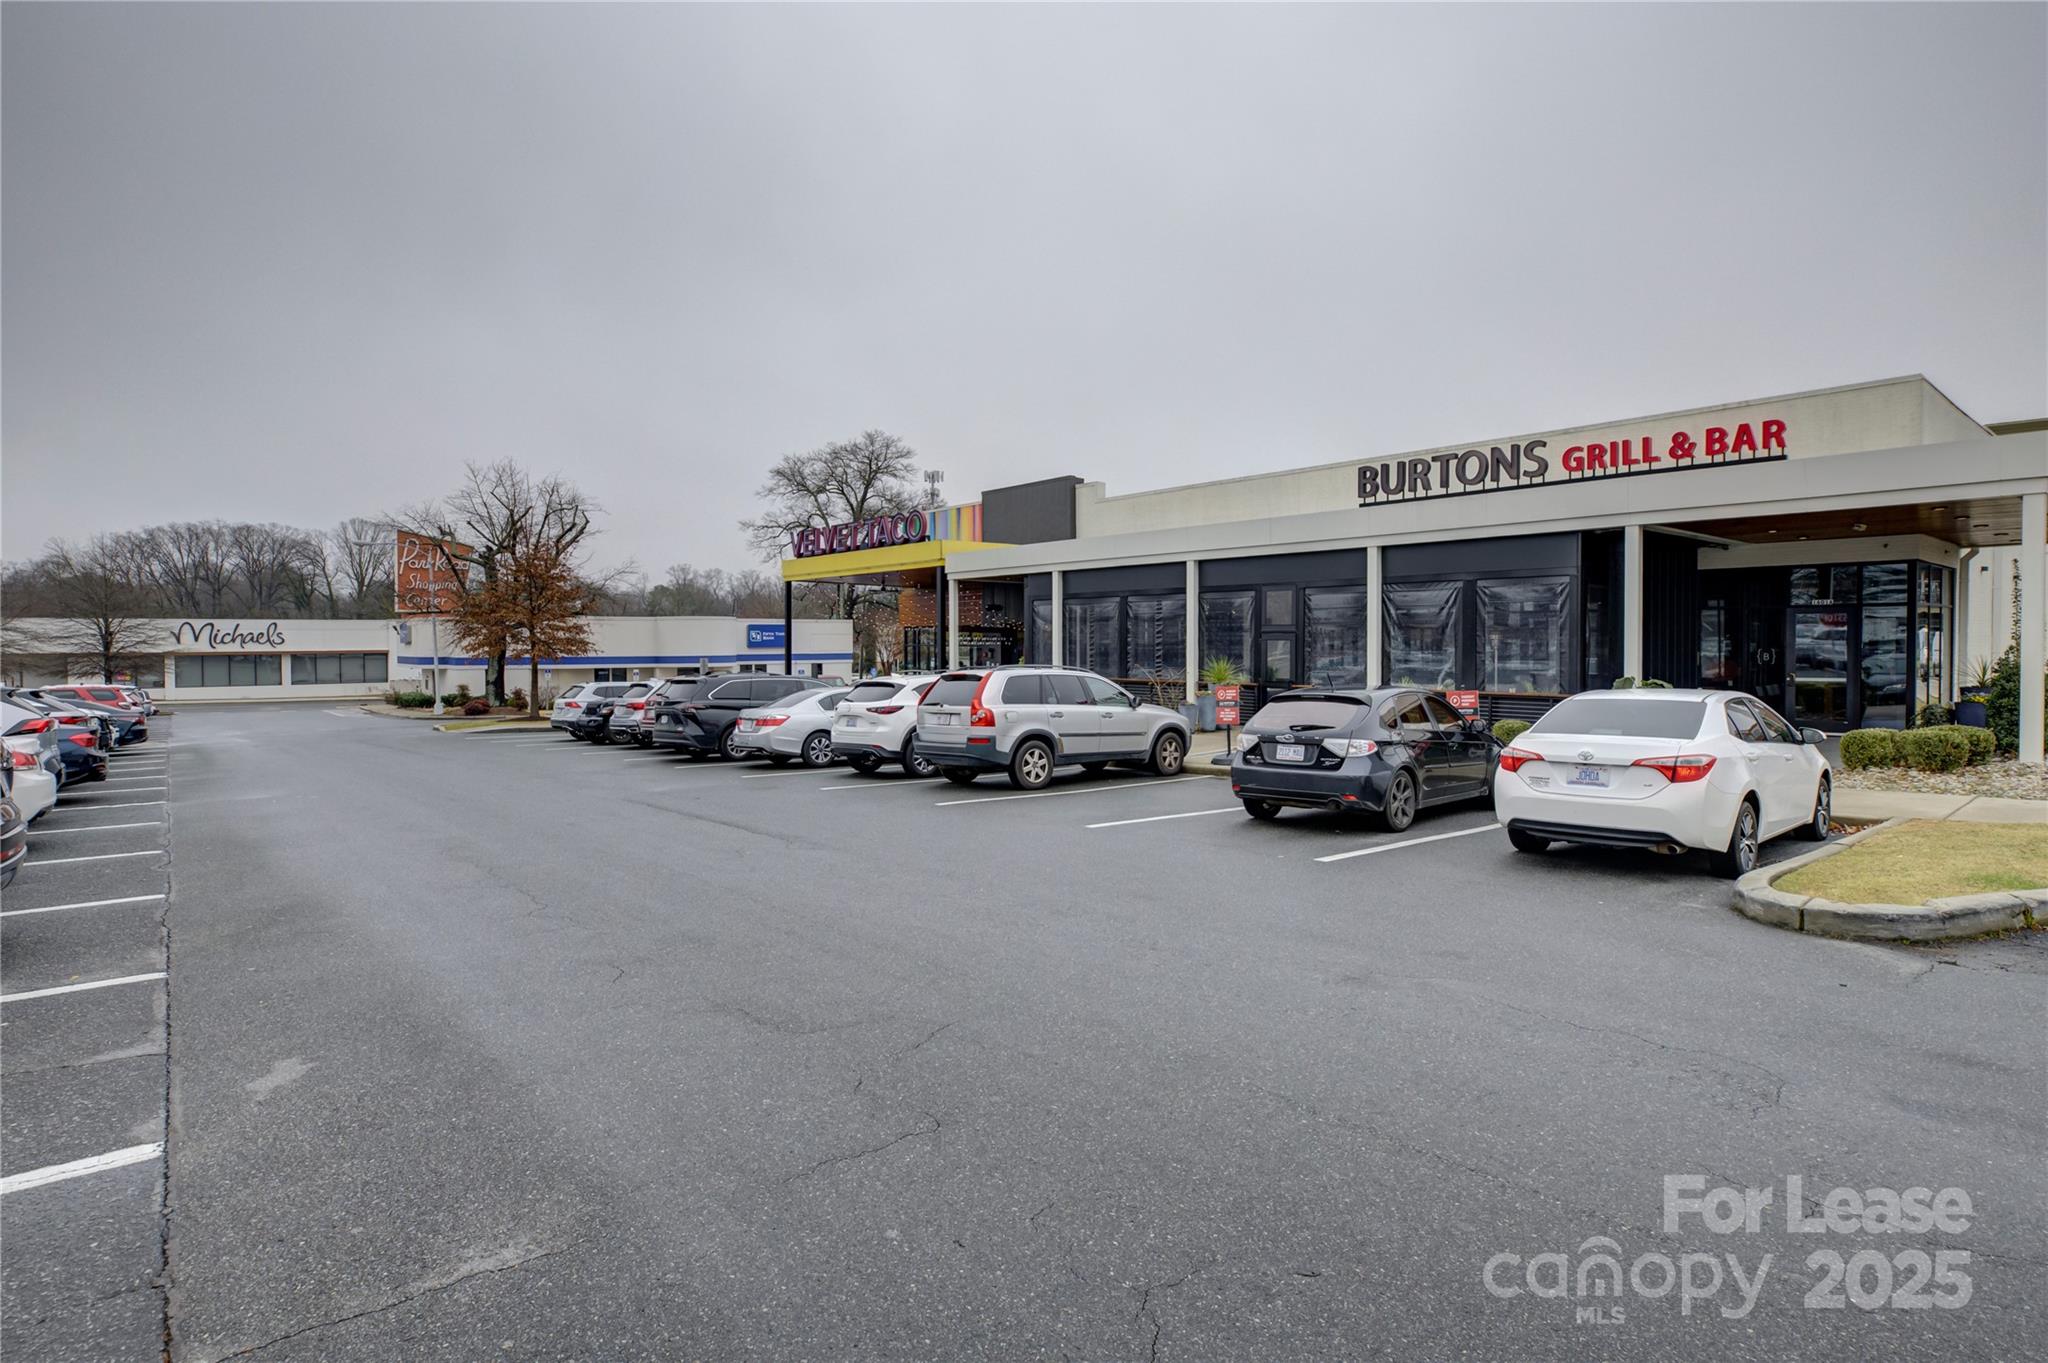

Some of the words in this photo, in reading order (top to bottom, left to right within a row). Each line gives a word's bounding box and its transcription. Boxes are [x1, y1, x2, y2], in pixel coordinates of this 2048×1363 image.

[1357, 439, 1549, 499] BURTONS
[1561, 436, 1662, 472] GRILL
[1668, 431, 1697, 460] &
[1705, 419, 1787, 456] BAR
[790, 521, 864, 559] VELVET
[864, 509, 928, 549] TACO
[170, 621, 286, 649] Michaels
